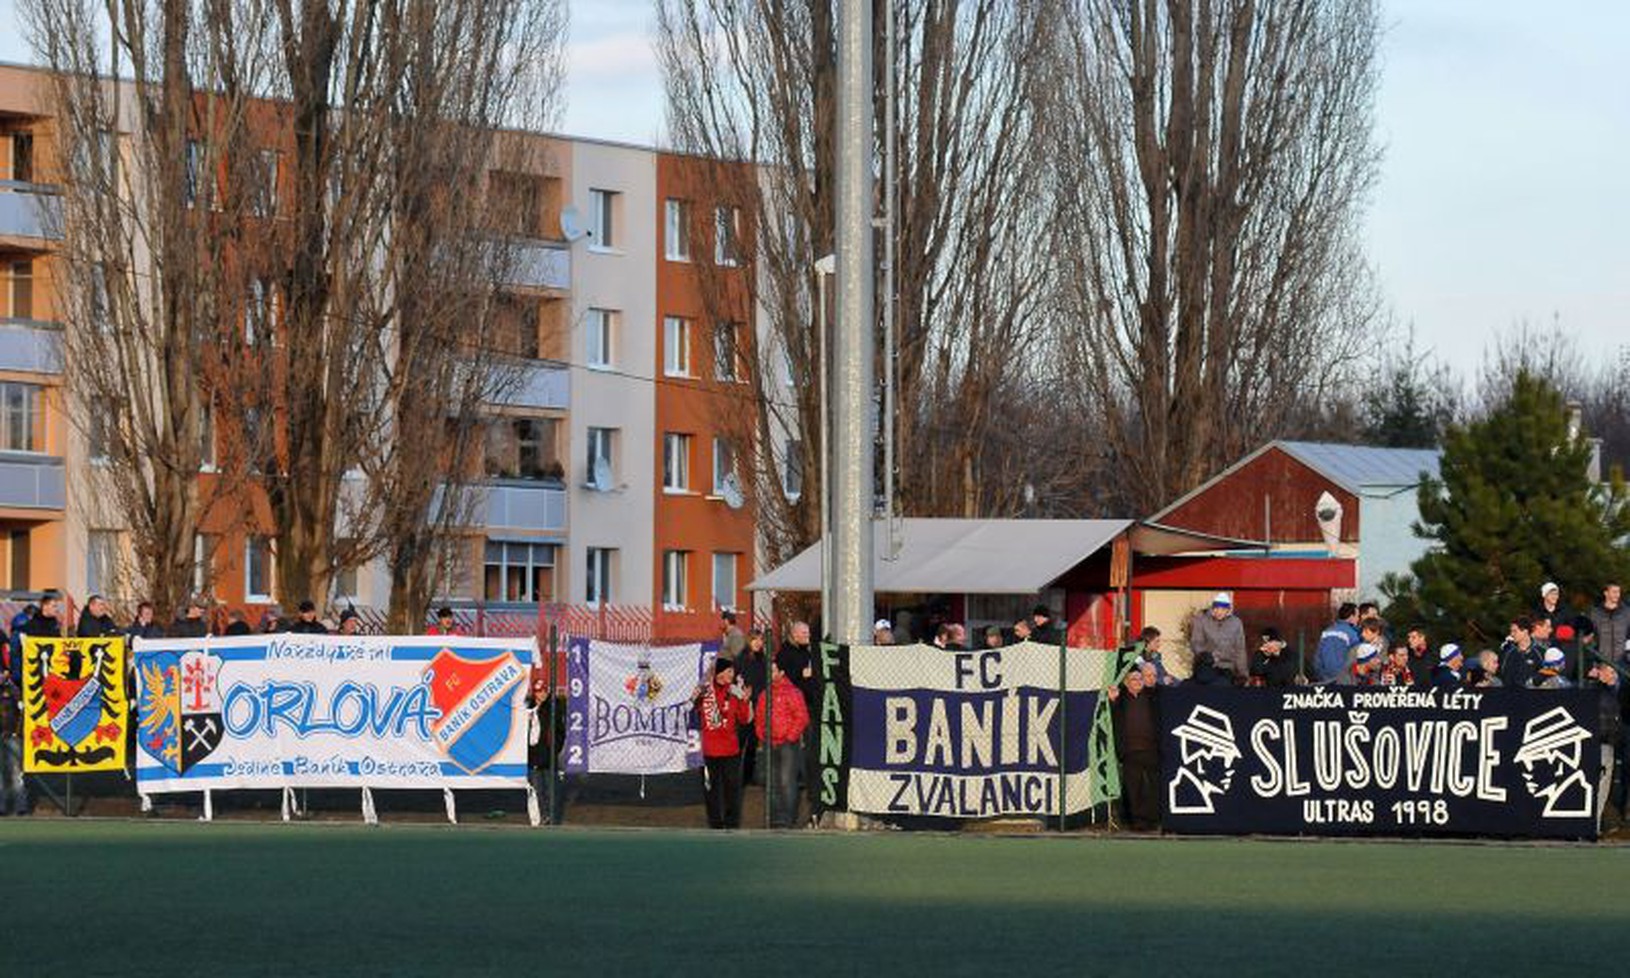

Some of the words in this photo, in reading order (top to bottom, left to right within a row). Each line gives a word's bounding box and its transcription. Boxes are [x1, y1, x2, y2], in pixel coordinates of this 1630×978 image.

[471, 664, 518, 710] OSTRAVA
[955, 652, 1002, 688] FC
[222, 668, 443, 742] ORLOVÁ
[1283, 686, 1344, 709] ZNAČKA
[1353, 686, 1438, 708] PROVĚŘENÁ
[1443, 688, 1483, 709] LÉTY
[820, 642, 843, 805] FANS
[886, 687, 1060, 769] BANÍK
[361, 756, 439, 776] Ostrava
[1251, 711, 1508, 802] SLUŠOVICE
[888, 774, 1051, 815] ZVALANCI
[1304, 800, 1374, 822] ULTRAS
[1392, 800, 1449, 824] 1998
